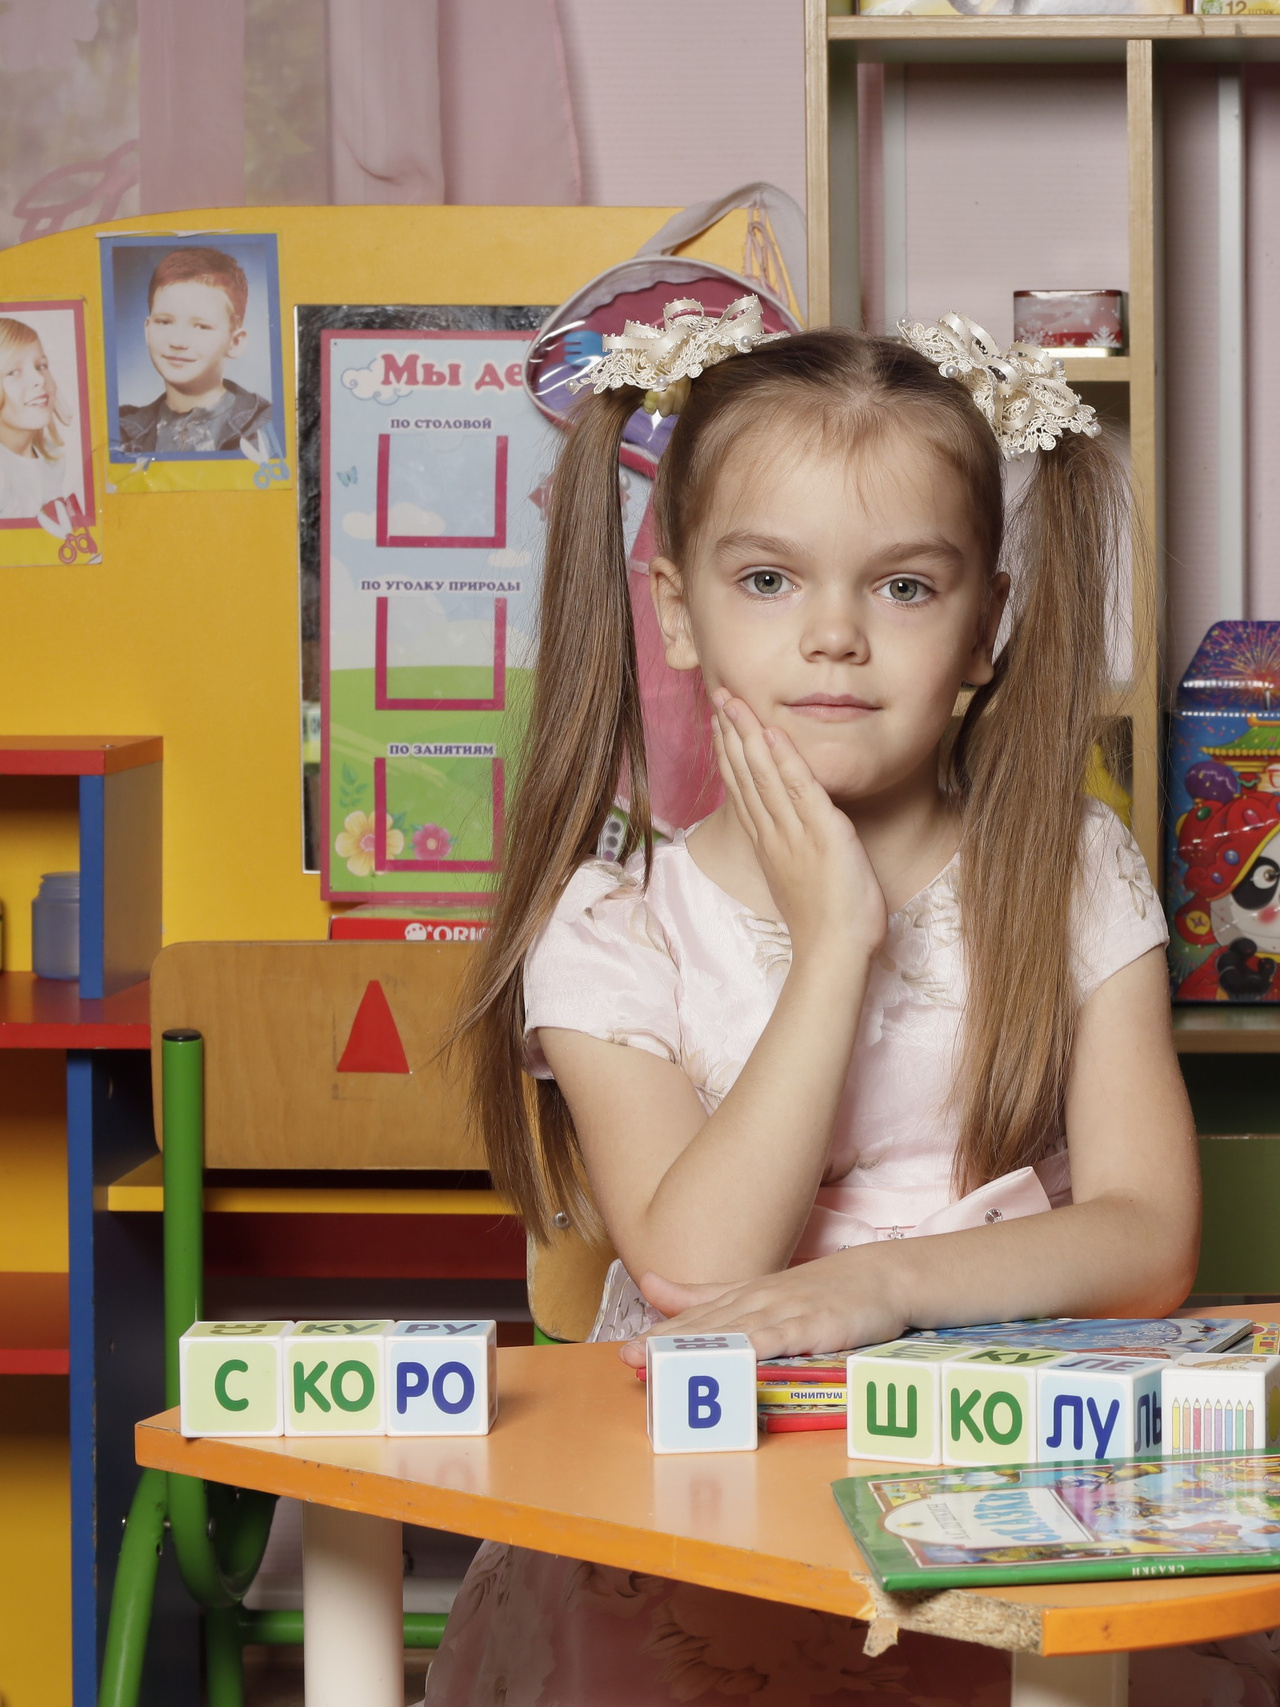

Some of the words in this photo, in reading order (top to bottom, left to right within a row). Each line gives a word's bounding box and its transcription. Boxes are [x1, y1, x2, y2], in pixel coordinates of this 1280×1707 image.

[381, 354, 461, 386] Мы
[474, 363, 523, 391] де
[391, 419, 410, 428] ПО
[415, 418, 491, 429] СТОЛОВОЙ
[361, 581, 380, 590] ПО
[386, 581, 444, 591] УГОЛКУ
[449, 581, 520, 592] ПРИРОДЫ
[390, 745, 409, 755] ПО
[413, 745, 494, 756] ЗАНЯТИЯМ
[433, 927, 491, 940] ORI
[301, 1323, 380, 1335] КУ
[404, 1323, 478, 1335] РУ
[967, 1350, 1055, 1364] КУ
[1059, 1358, 1145, 1372] ЛЕ
[790, 1391, 843, 1400] МАШИНЫ
[688, 1375, 722, 1429] В
[1132, 1565, 1185, 1576] СКАЗКИ
